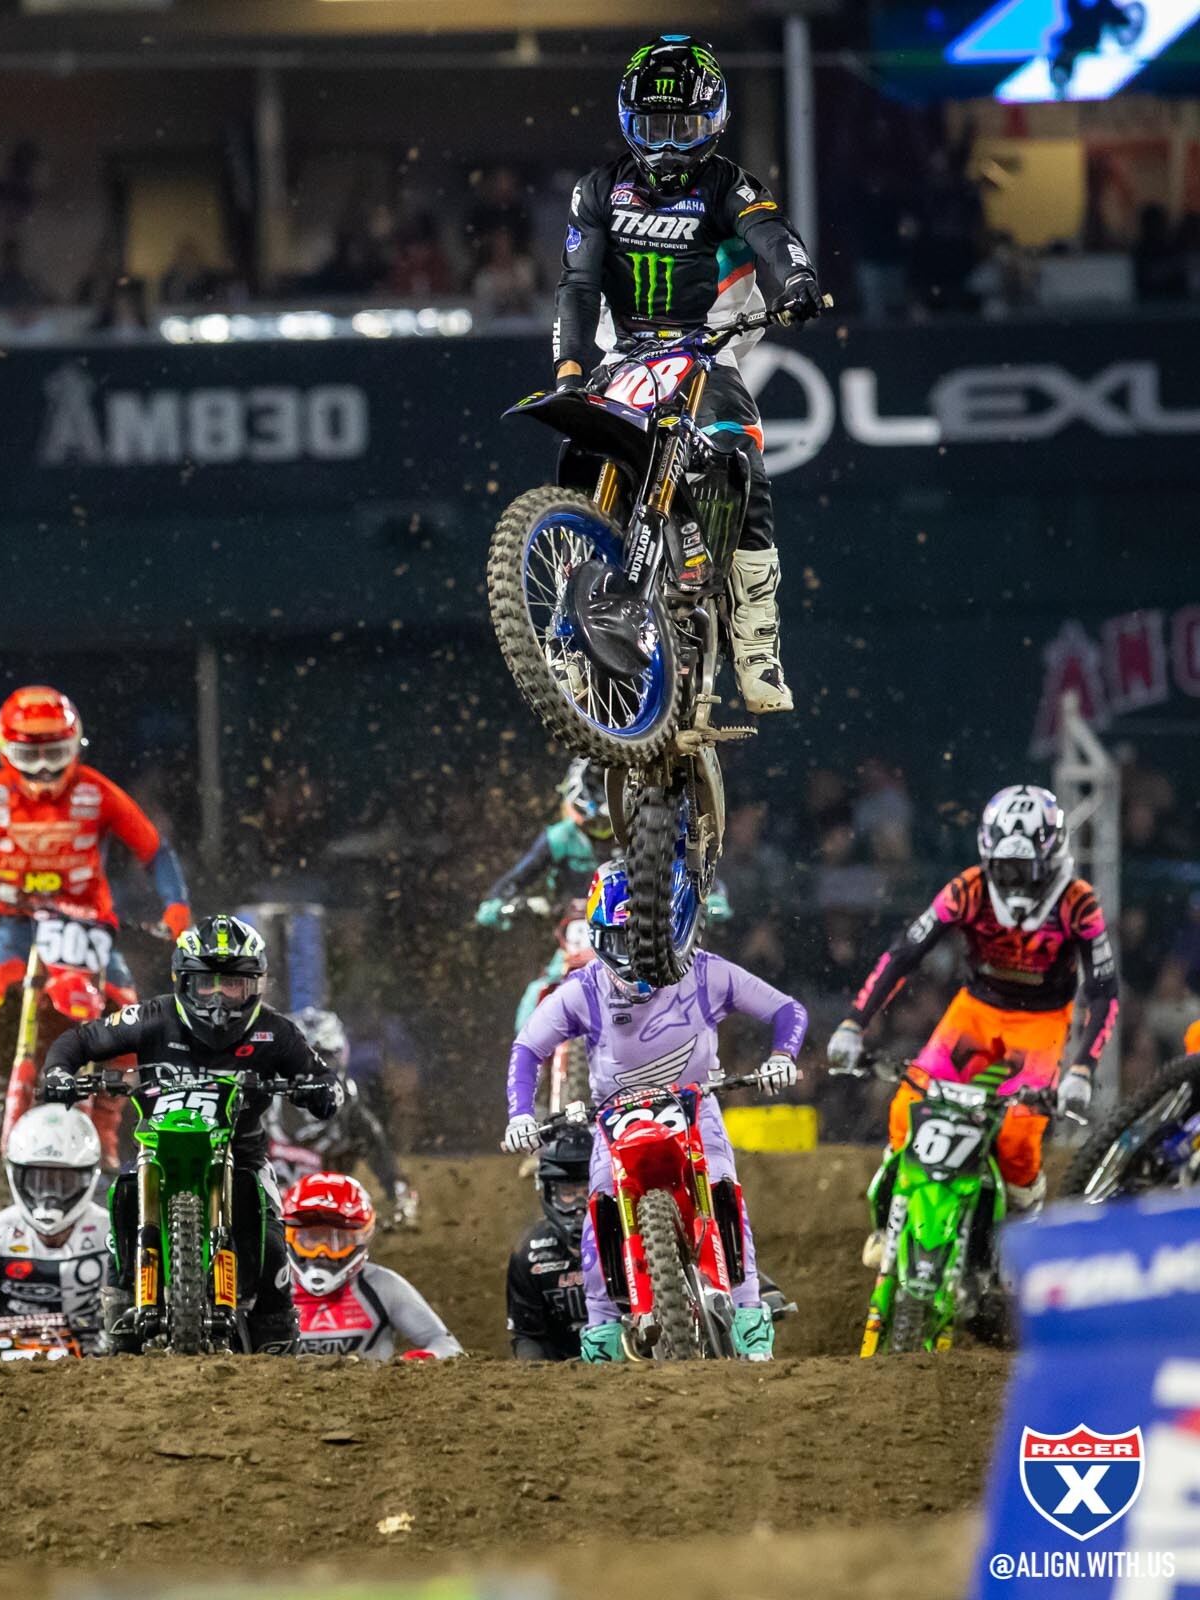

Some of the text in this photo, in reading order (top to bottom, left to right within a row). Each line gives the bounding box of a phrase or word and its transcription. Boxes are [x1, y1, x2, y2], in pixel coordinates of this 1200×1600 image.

[611, 209, 700, 240] THOR
[630, 239, 646, 247] FIRST
[628, 524, 651, 583] DUNLOP
[914, 1119, 983, 1168] 67
[625, 1257, 638, 1305] DUNLOP
[711, 1234, 729, 1288] DUNLOP
